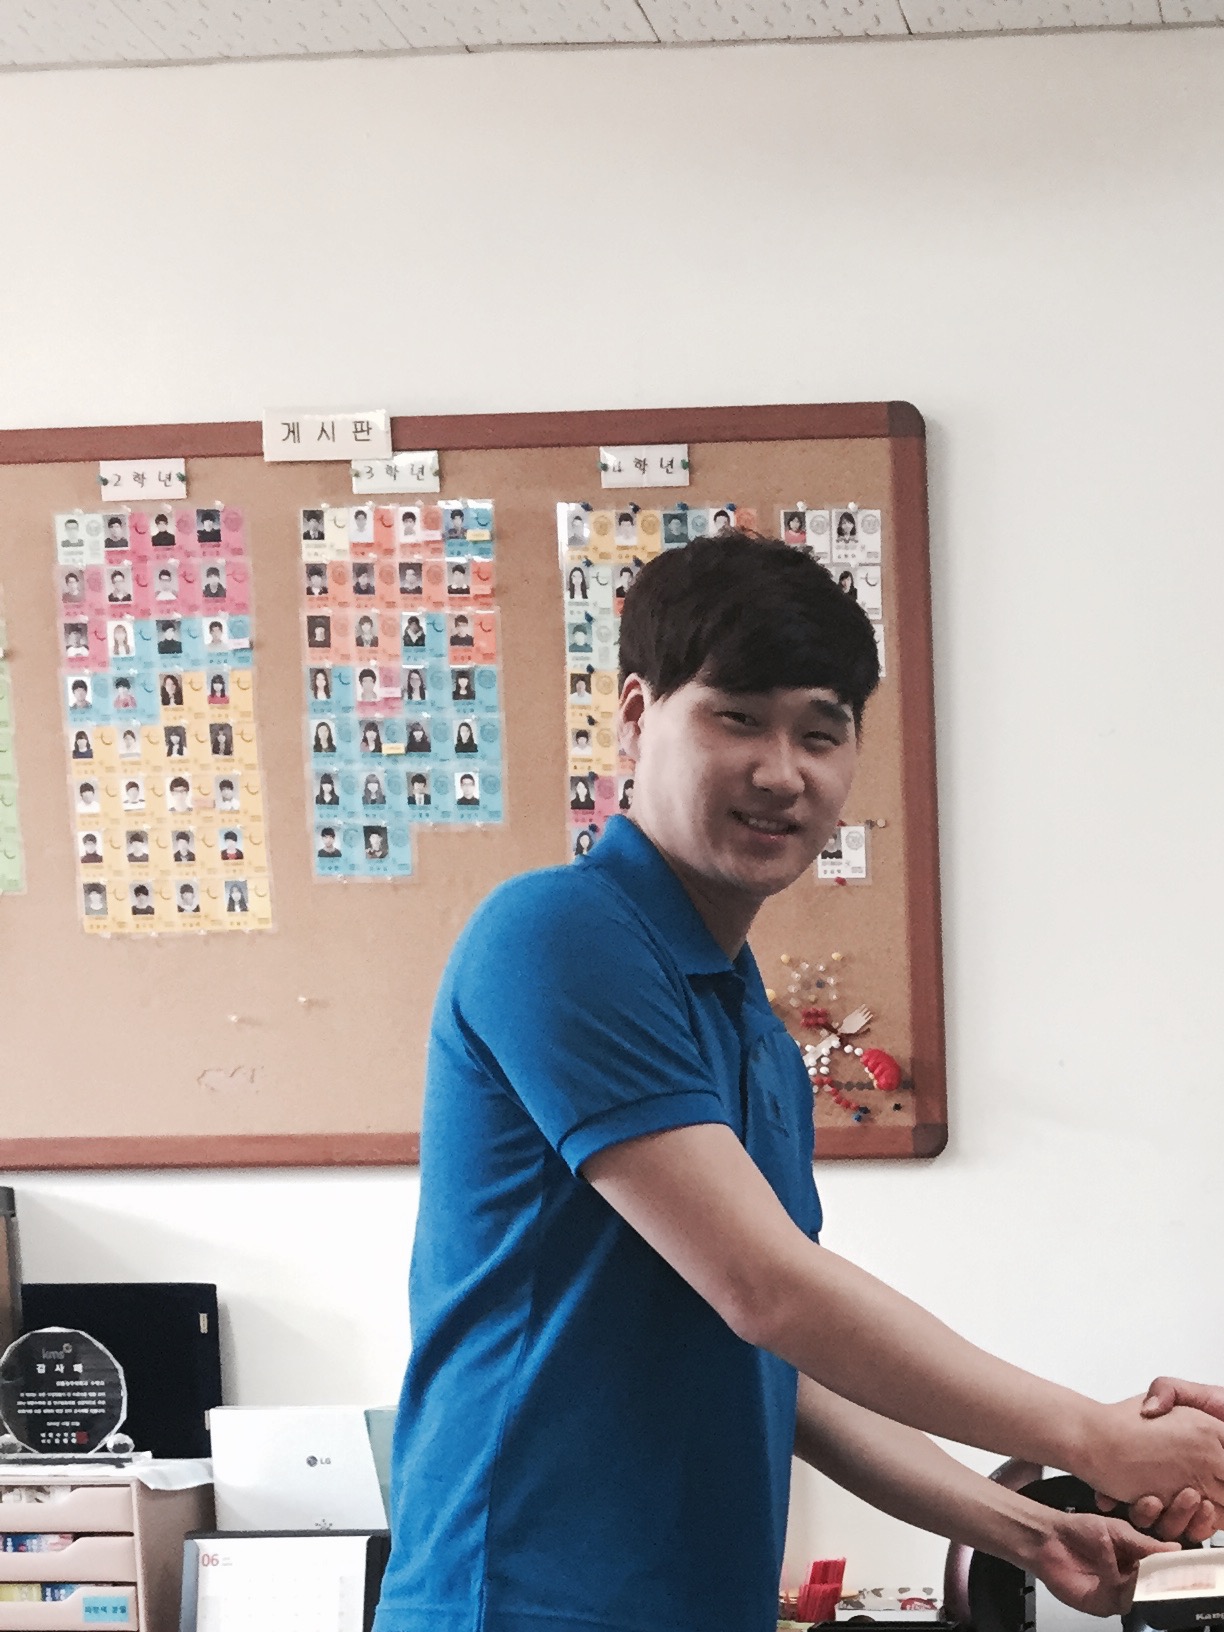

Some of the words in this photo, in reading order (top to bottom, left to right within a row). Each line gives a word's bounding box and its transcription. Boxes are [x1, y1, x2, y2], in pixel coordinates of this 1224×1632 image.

[282, 420, 373, 443] 게시판
[320, 1457, 331, 1465] LG
[201, 1553, 219, 1567] 06
